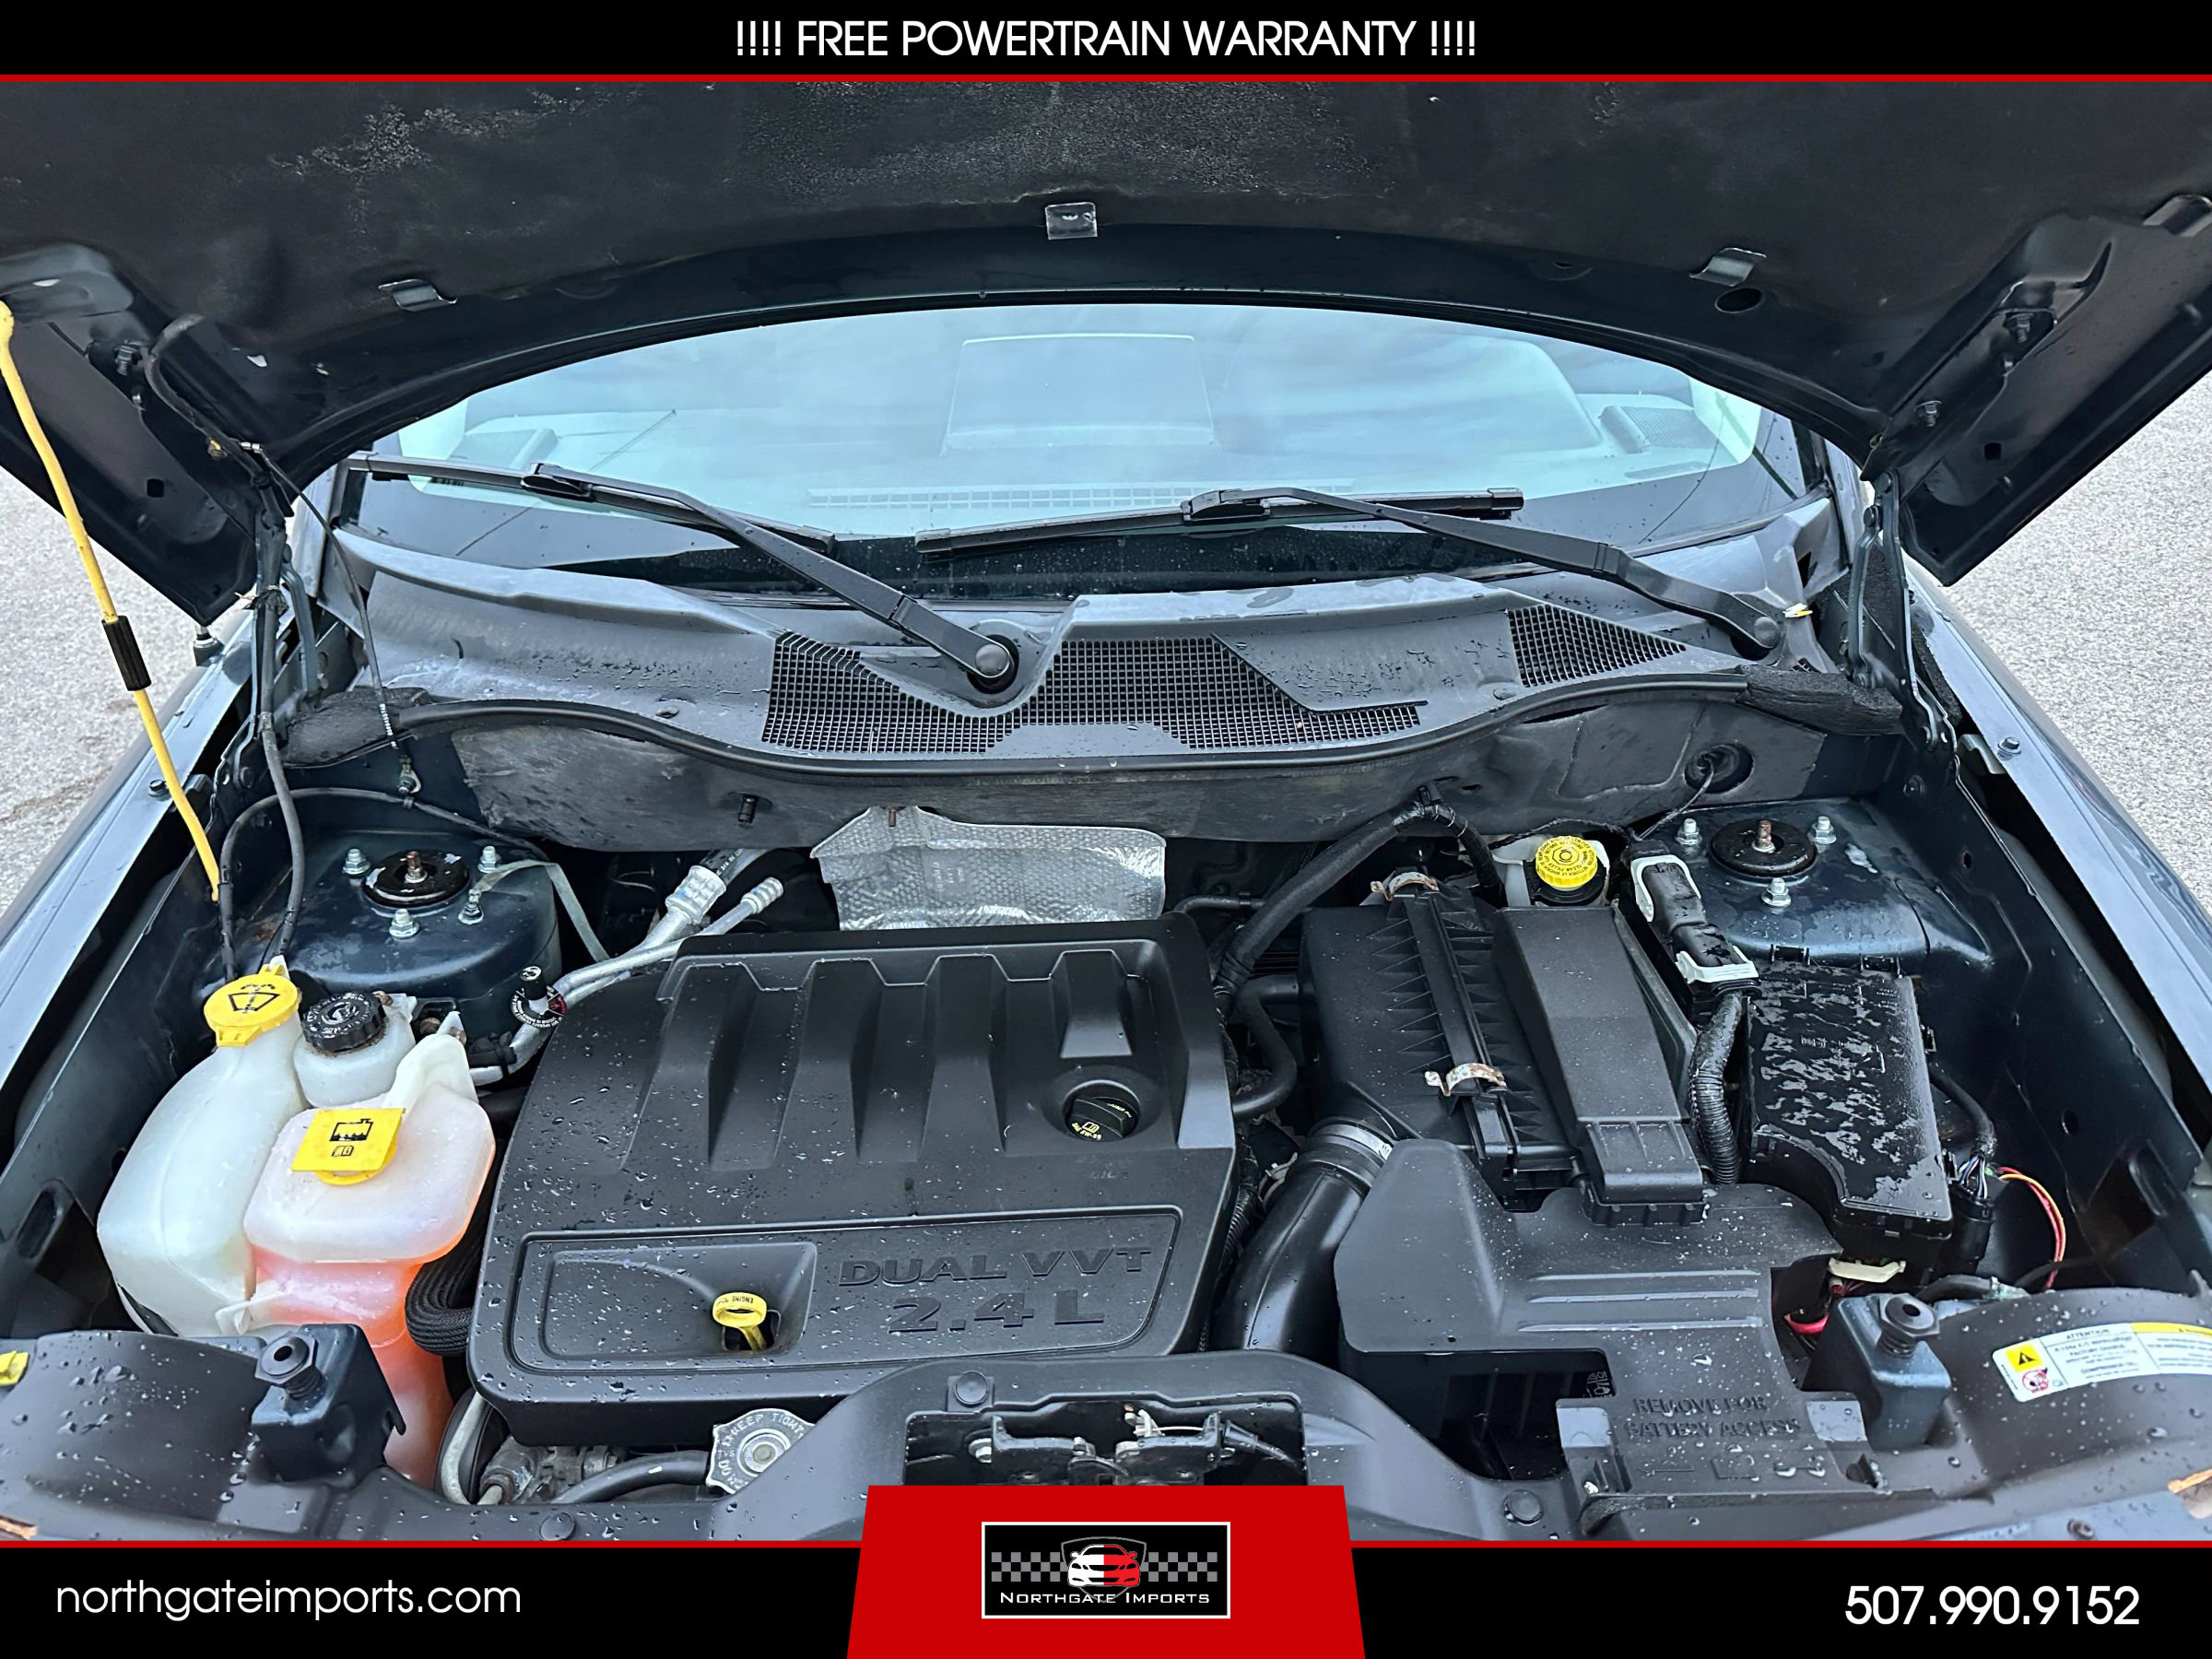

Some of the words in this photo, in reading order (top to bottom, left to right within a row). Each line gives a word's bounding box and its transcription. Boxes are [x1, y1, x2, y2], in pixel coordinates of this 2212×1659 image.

[839, 1254, 1007, 1286] DUAL
[1019, 1245, 1151, 1277] VVT
[1632, 1396, 1721, 1414] REMOVE
[1724, 1394, 1768, 1411] FOR
[1624, 1420, 1712, 1438] BATTERY
[1720, 1418, 1802, 1437] ACCESS
